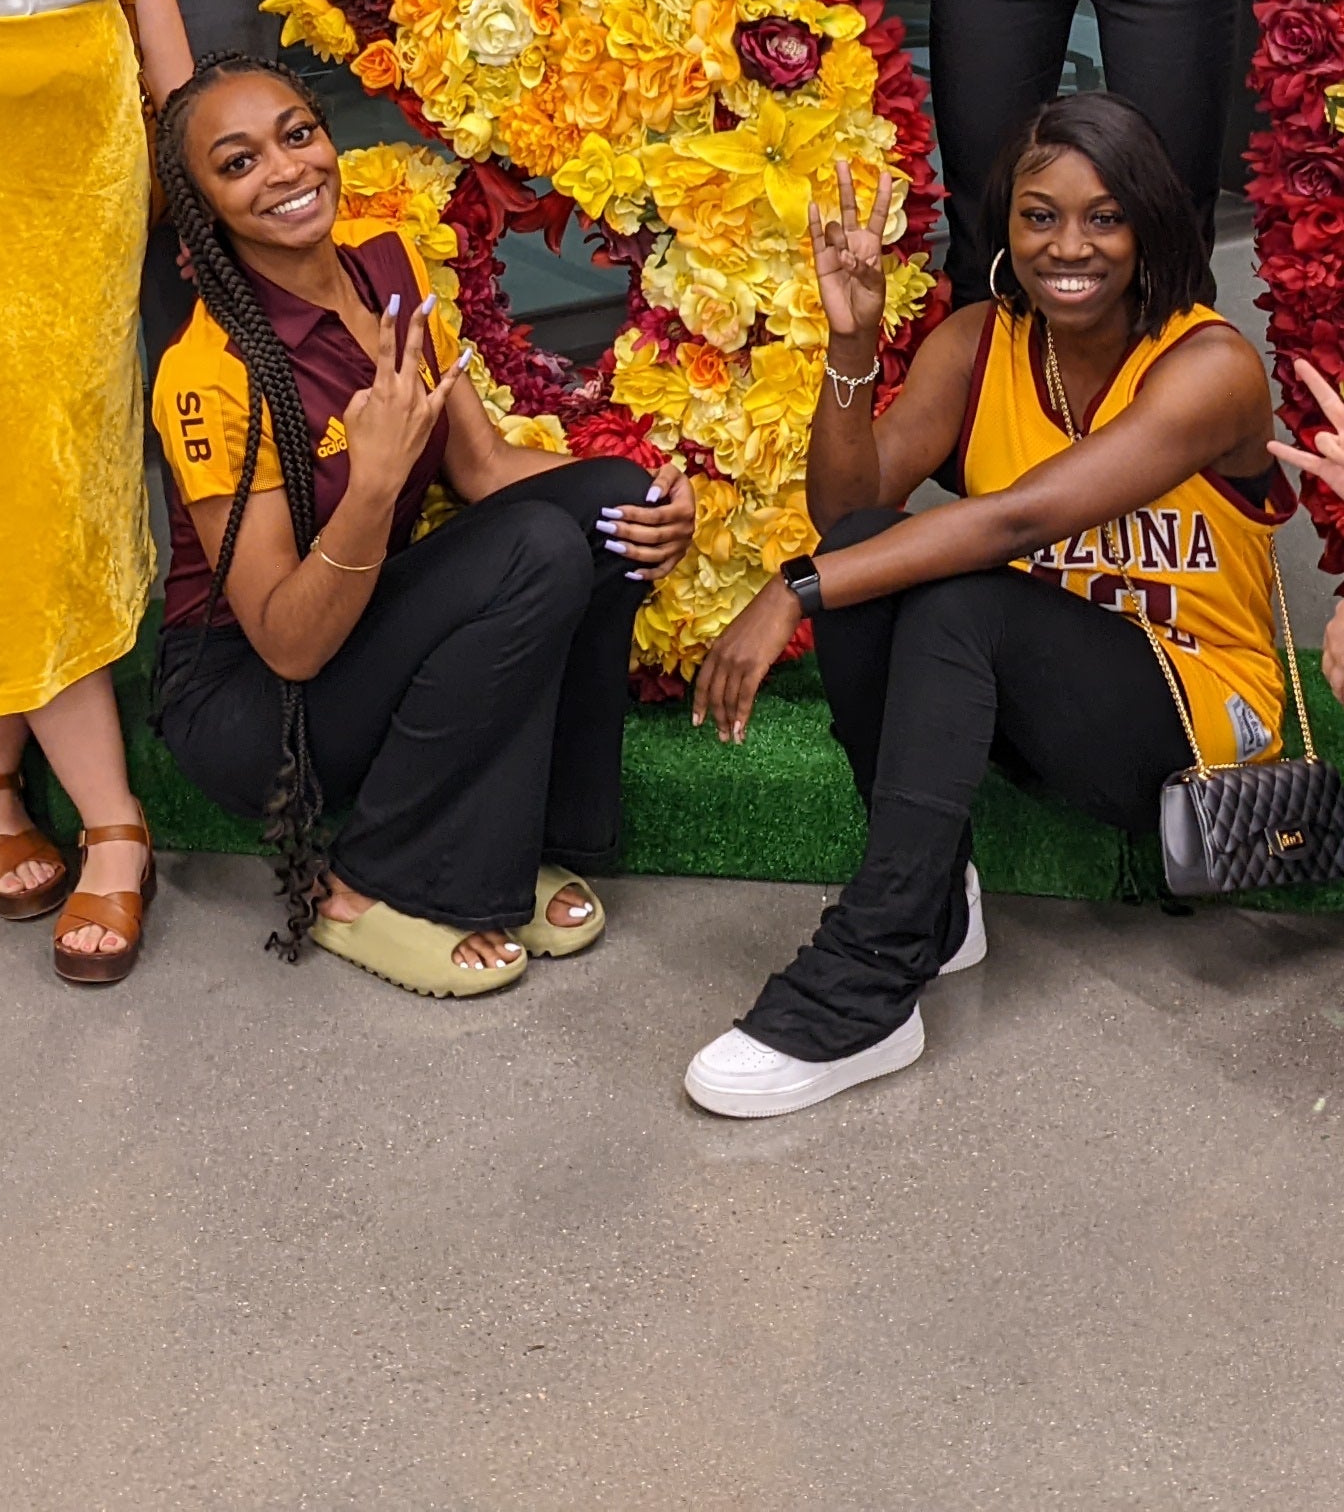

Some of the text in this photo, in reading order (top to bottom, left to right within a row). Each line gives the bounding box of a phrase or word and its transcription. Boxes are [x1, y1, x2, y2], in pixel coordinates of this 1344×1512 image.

[176, 391, 212, 463] SLB
[317, 437, 348, 458] adid
[1031, 509, 1218, 572] ZONA
